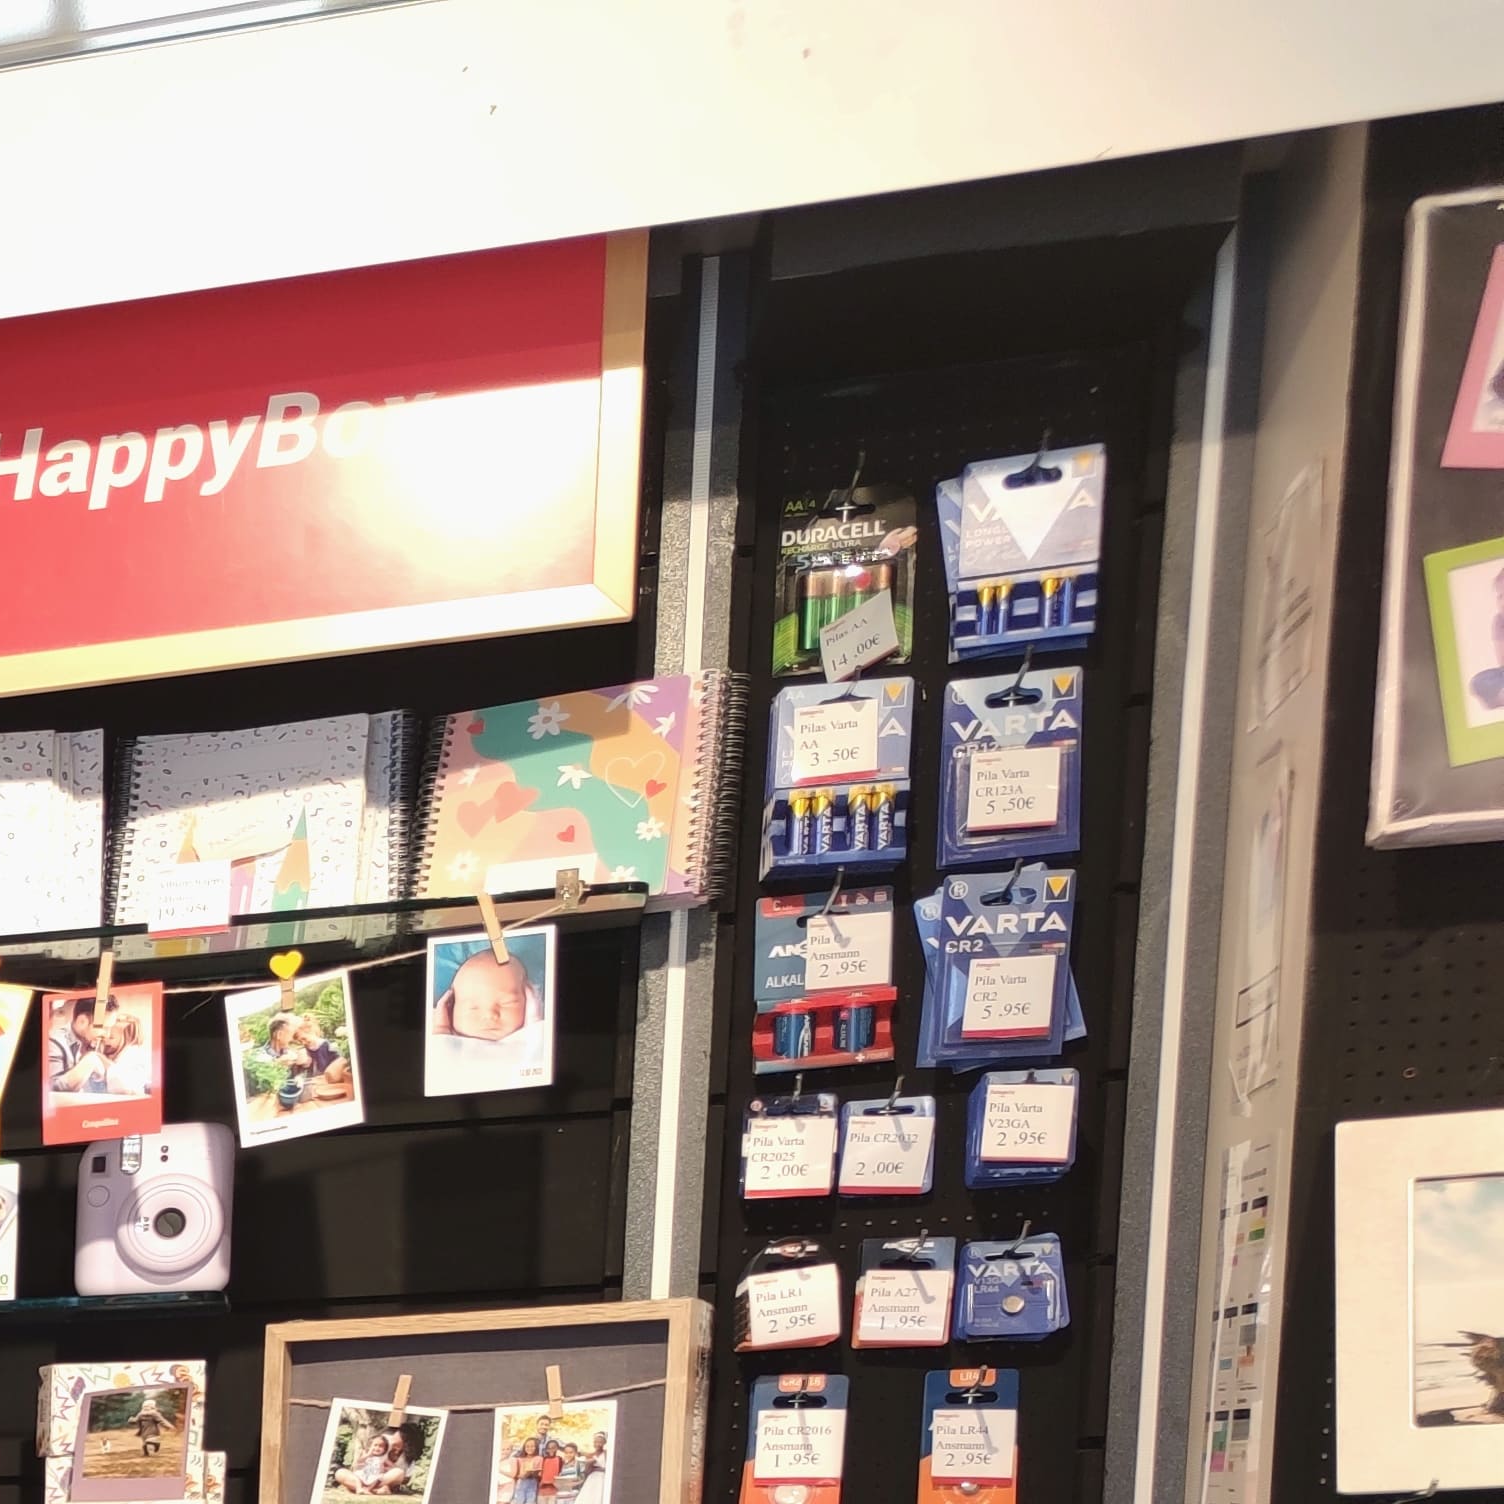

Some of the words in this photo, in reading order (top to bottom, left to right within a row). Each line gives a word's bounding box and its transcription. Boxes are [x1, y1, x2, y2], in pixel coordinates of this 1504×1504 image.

[781, 520, 886, 547] DURACELL
[950, 710, 1078, 741] VARTA
[977, 769, 999, 780] Pila
[1003, 768, 1029, 779] Varta
[975, 786, 1023, 798] CR123A
[945, 911, 1066, 936] VARTA
[945, 939, 983, 953] CR2
[764, 1425, 784, 1436] Pila
[787, 1425, 832, 1435] CR2016
[763, 1441, 813, 1451] Ansmann
